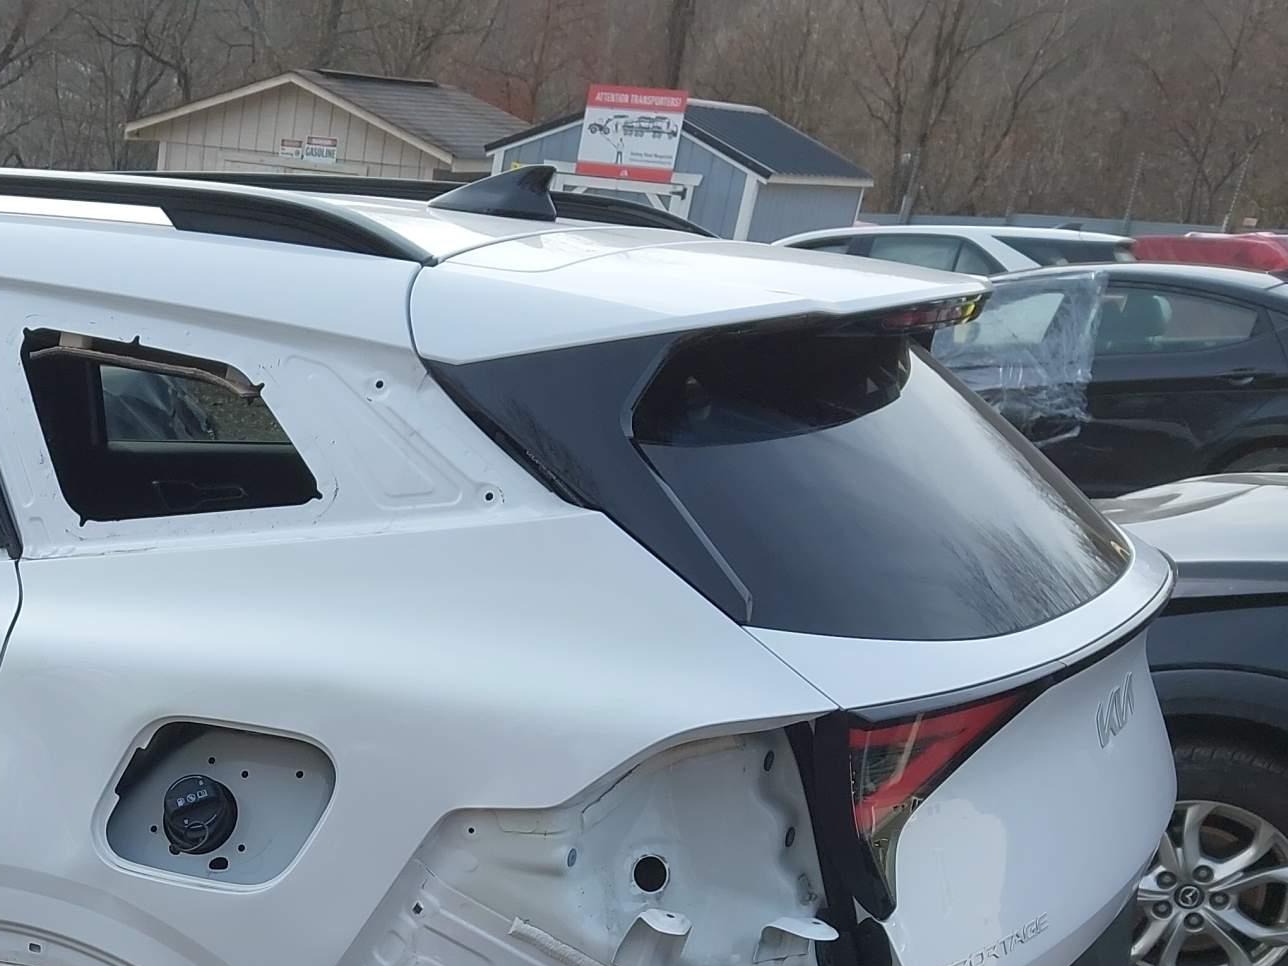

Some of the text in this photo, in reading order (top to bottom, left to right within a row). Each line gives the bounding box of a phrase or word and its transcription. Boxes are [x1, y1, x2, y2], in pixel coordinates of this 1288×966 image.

[595, 91, 682, 107] ATTENTION TRANSPORTERS!
[305, 146, 336, 159] GASOLINE
